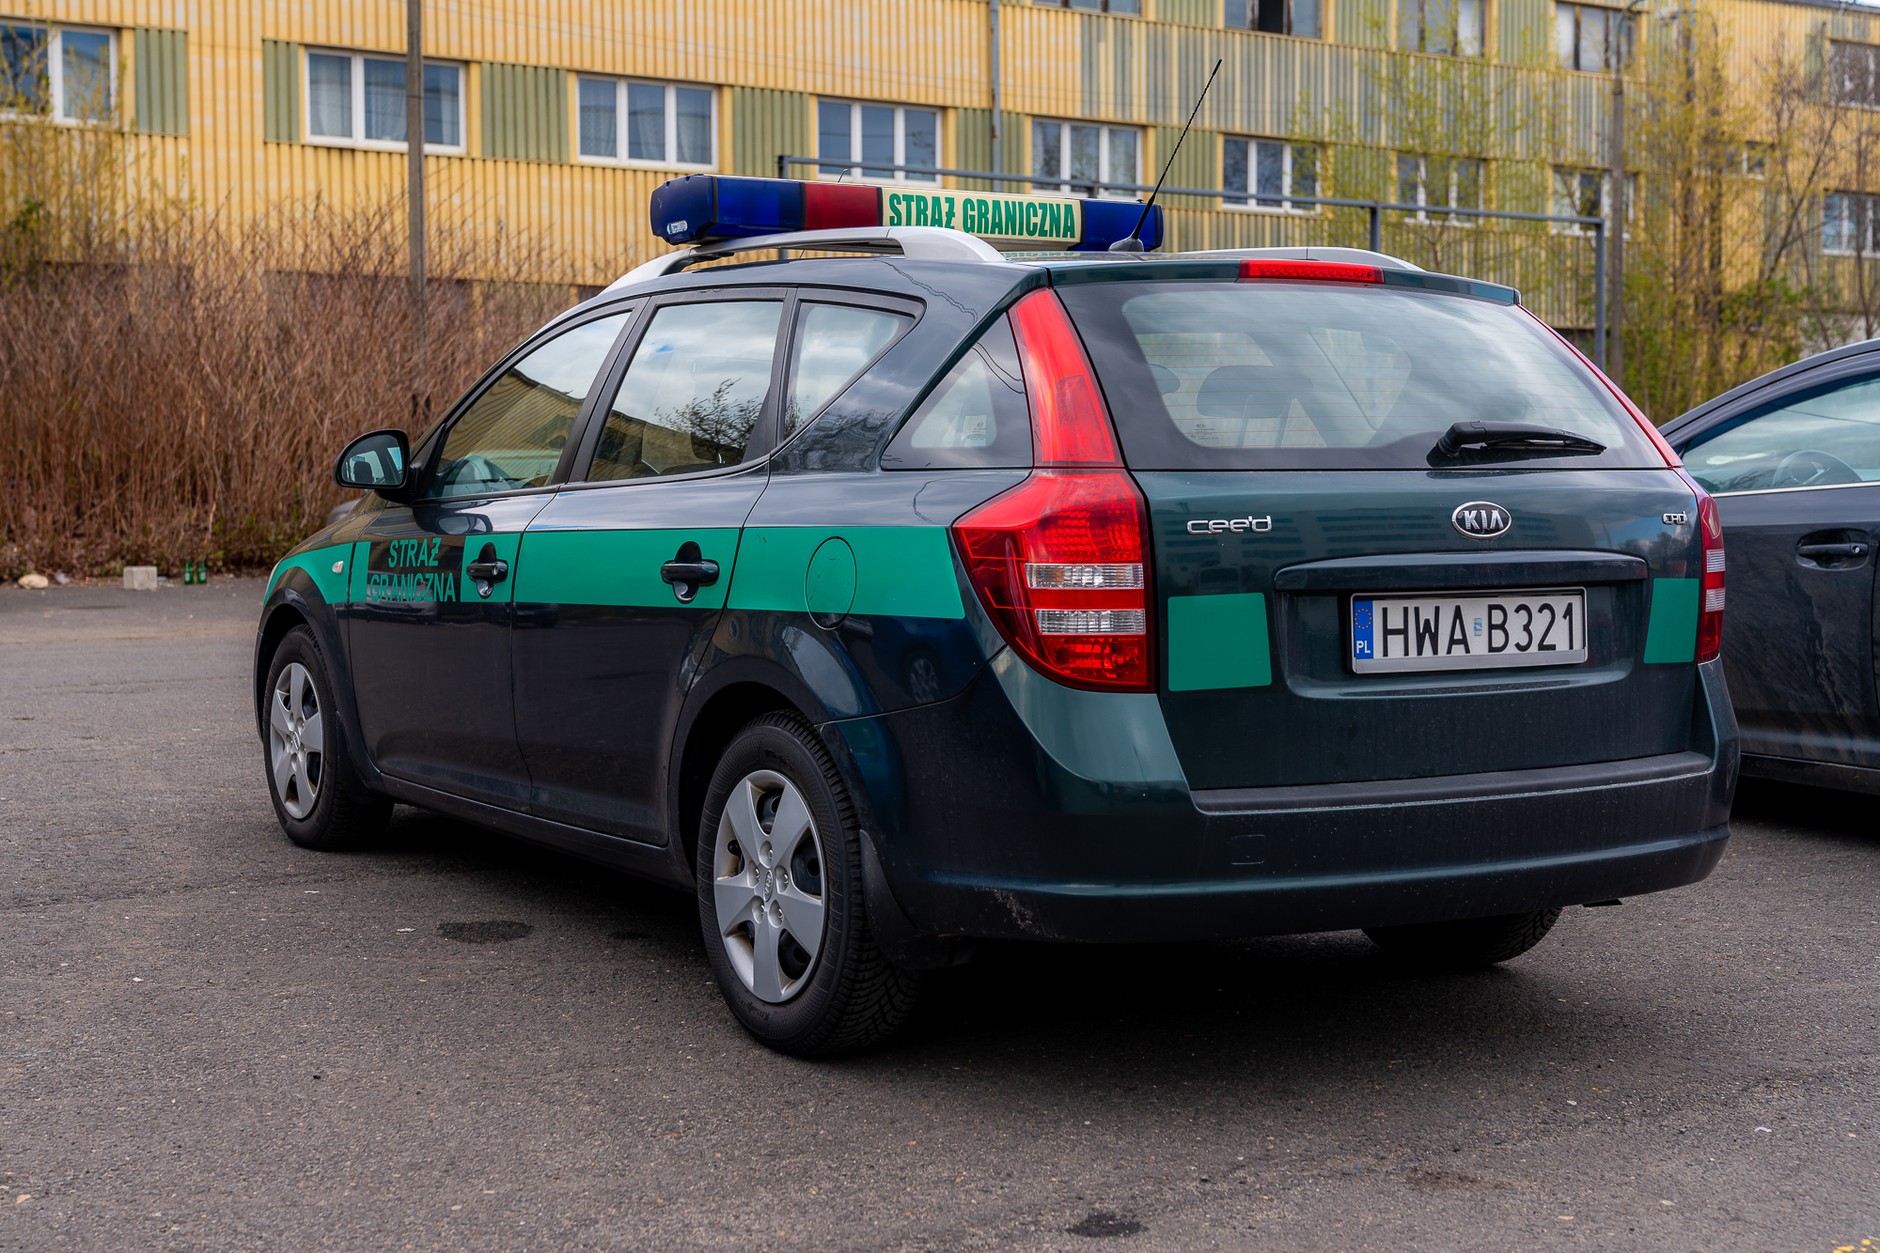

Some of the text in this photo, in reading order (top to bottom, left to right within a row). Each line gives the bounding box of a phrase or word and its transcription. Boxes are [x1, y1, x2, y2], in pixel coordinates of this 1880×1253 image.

[962, 197, 1076, 239] GRANICZNA
[1186, 515, 1273, 535] cee'd
[1462, 509, 1504, 530] KIA
[369, 572, 456, 602] GRANICZNA
[1382, 602, 1574, 658] HWA B321
[1356, 640, 1371, 654] PL
